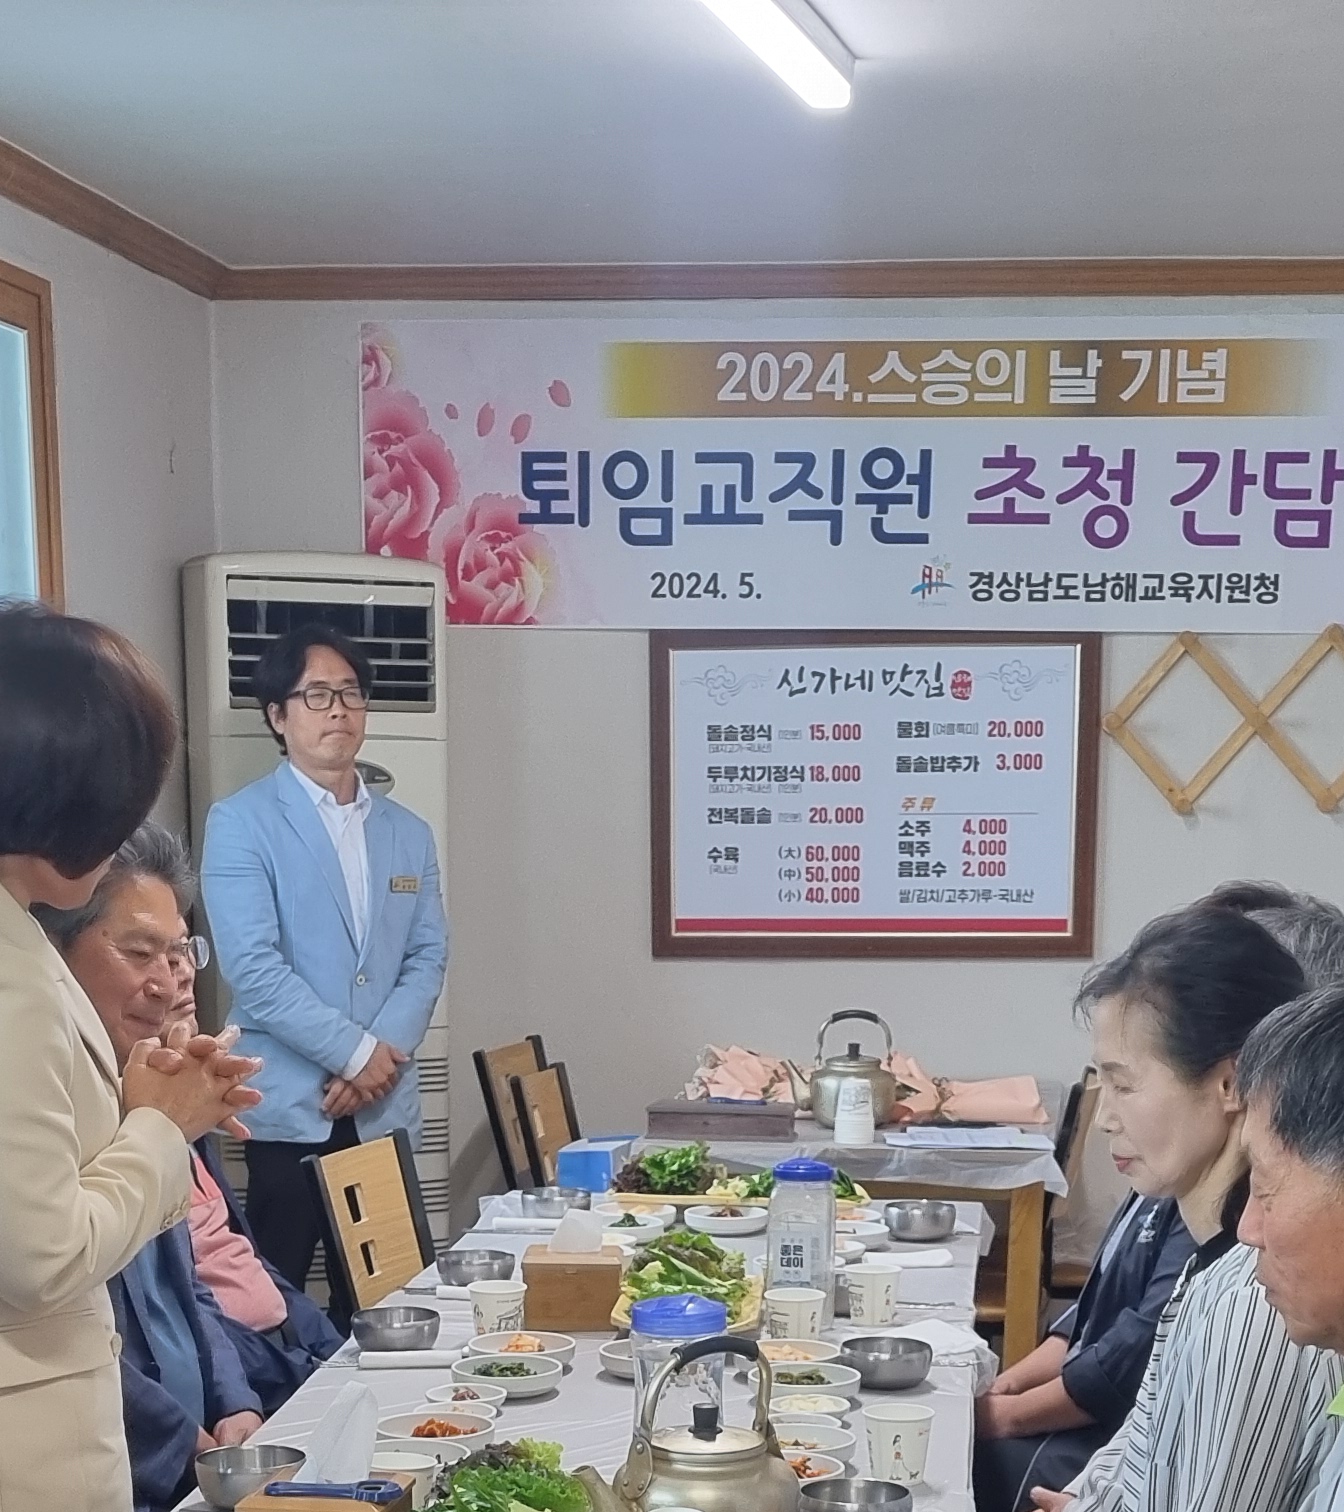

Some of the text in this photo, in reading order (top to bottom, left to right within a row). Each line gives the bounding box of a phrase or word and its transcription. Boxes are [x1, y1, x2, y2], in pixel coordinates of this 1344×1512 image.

[716, 347, 1229, 405] 2024.스승의 날 기념
[517, 446, 934, 547] 퇴임교직원
[966, 444, 1137, 549] 초청
[649, 572, 763, 600] 2024. 5.
[967, 571, 1281, 605] 경상남도남해교육지원청
[809, 723, 862, 741] 15,000
[897, 721, 930, 739] 물회
[987, 720, 1044, 738] 20,000
[996, 753, 1043, 771] 3,000
[706, 765, 862, 783] 두루치기정식 18,000
[808, 806, 864, 824] 20,000
[898, 818, 1008, 838] 소주 4,000
[707, 846, 740, 864] 수육
[805, 845, 860, 863] 60,000
[898, 839, 1007, 858] 맥주 4,000
[805, 866, 860, 883] 50,000
[898, 860, 1006, 878] 음료수 2,000
[805, 886, 860, 904] 40,000
